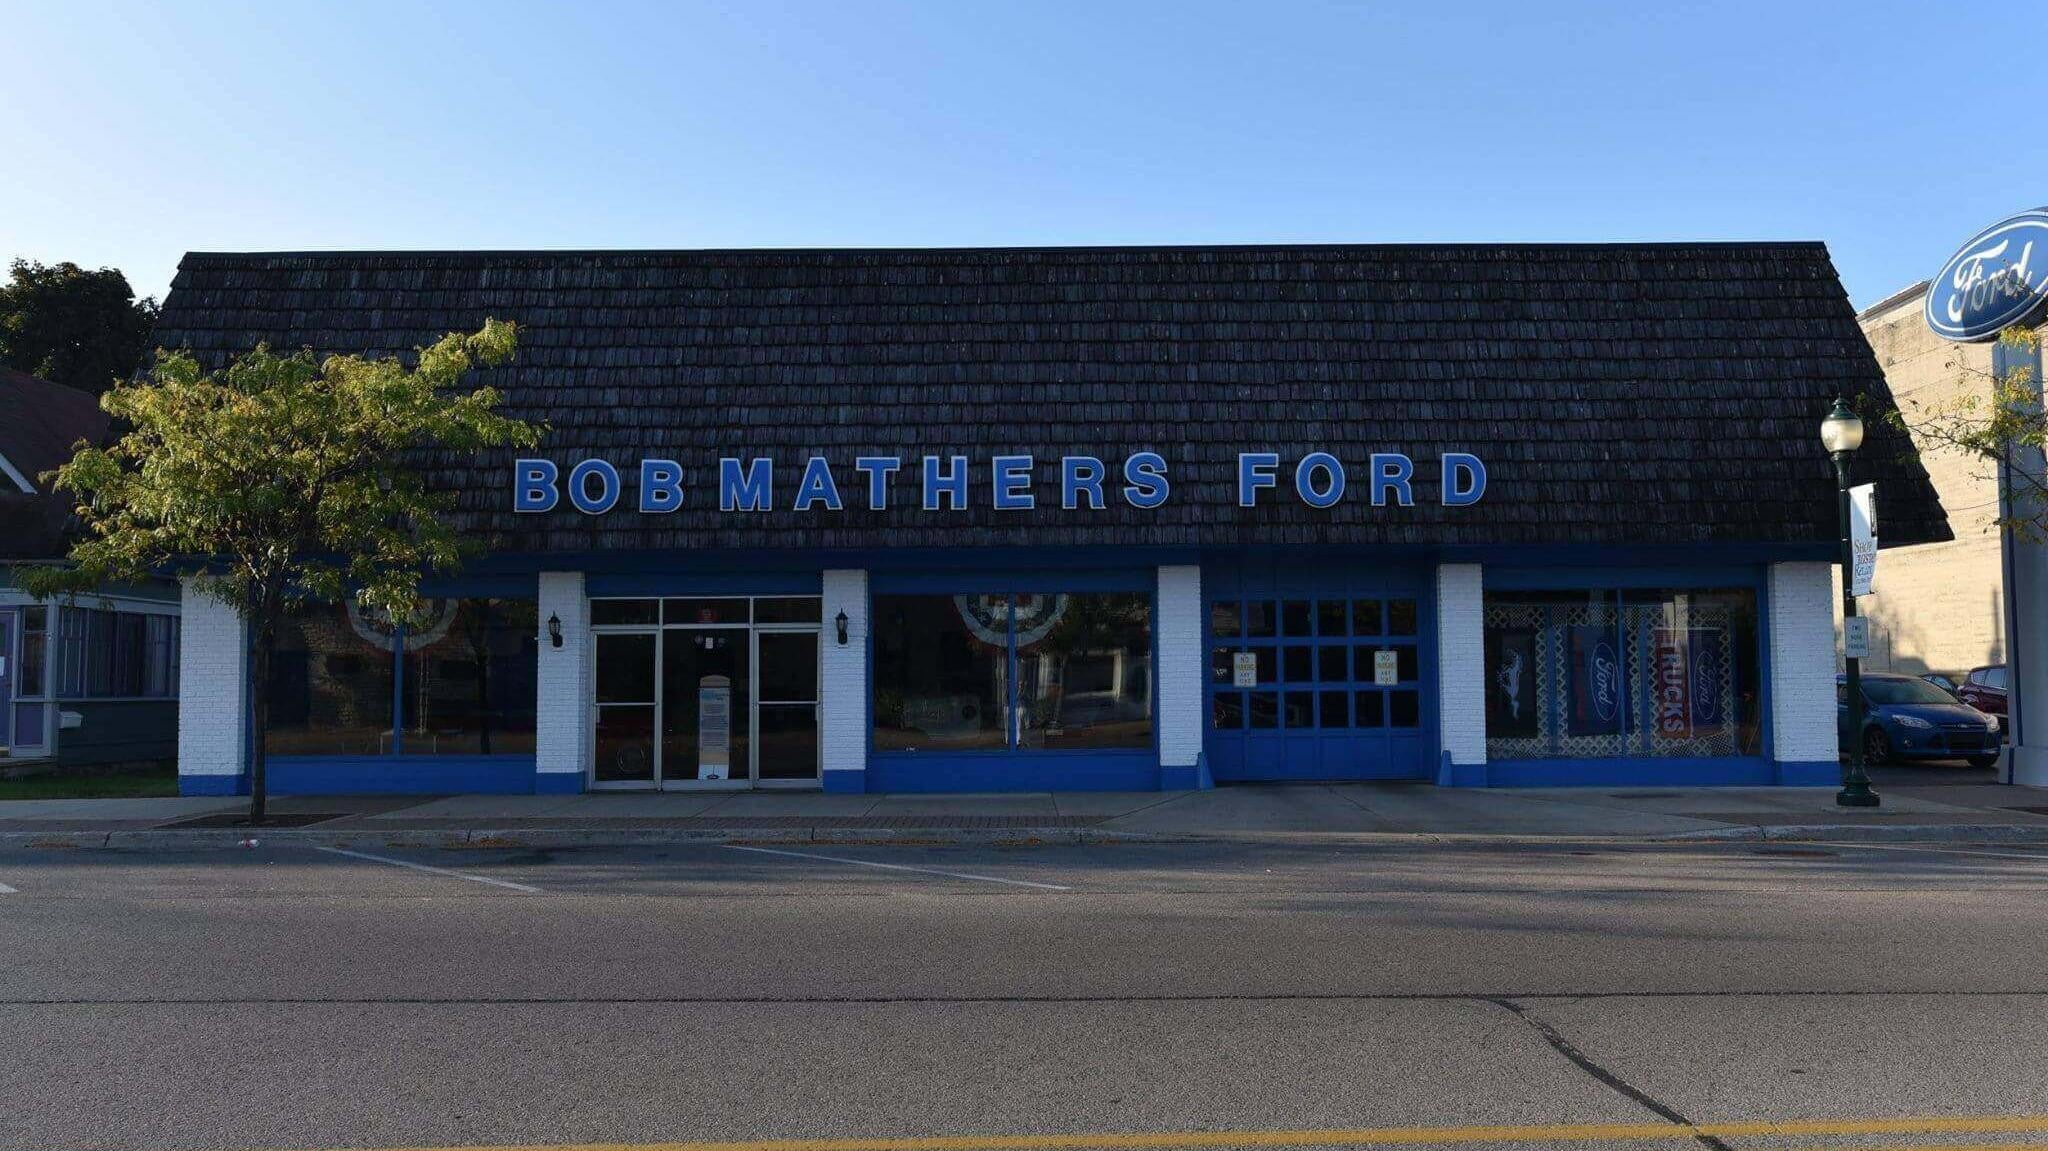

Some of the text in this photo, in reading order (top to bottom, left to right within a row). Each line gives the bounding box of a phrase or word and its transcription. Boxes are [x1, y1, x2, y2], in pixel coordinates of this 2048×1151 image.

[1947, 239, 2033, 323] Ford
[513, 452, 1488, 515] BOB MATHERS FORD
[1595, 657, 1617, 705] Ford
[1660, 637, 1685, 733] TRUCKS
